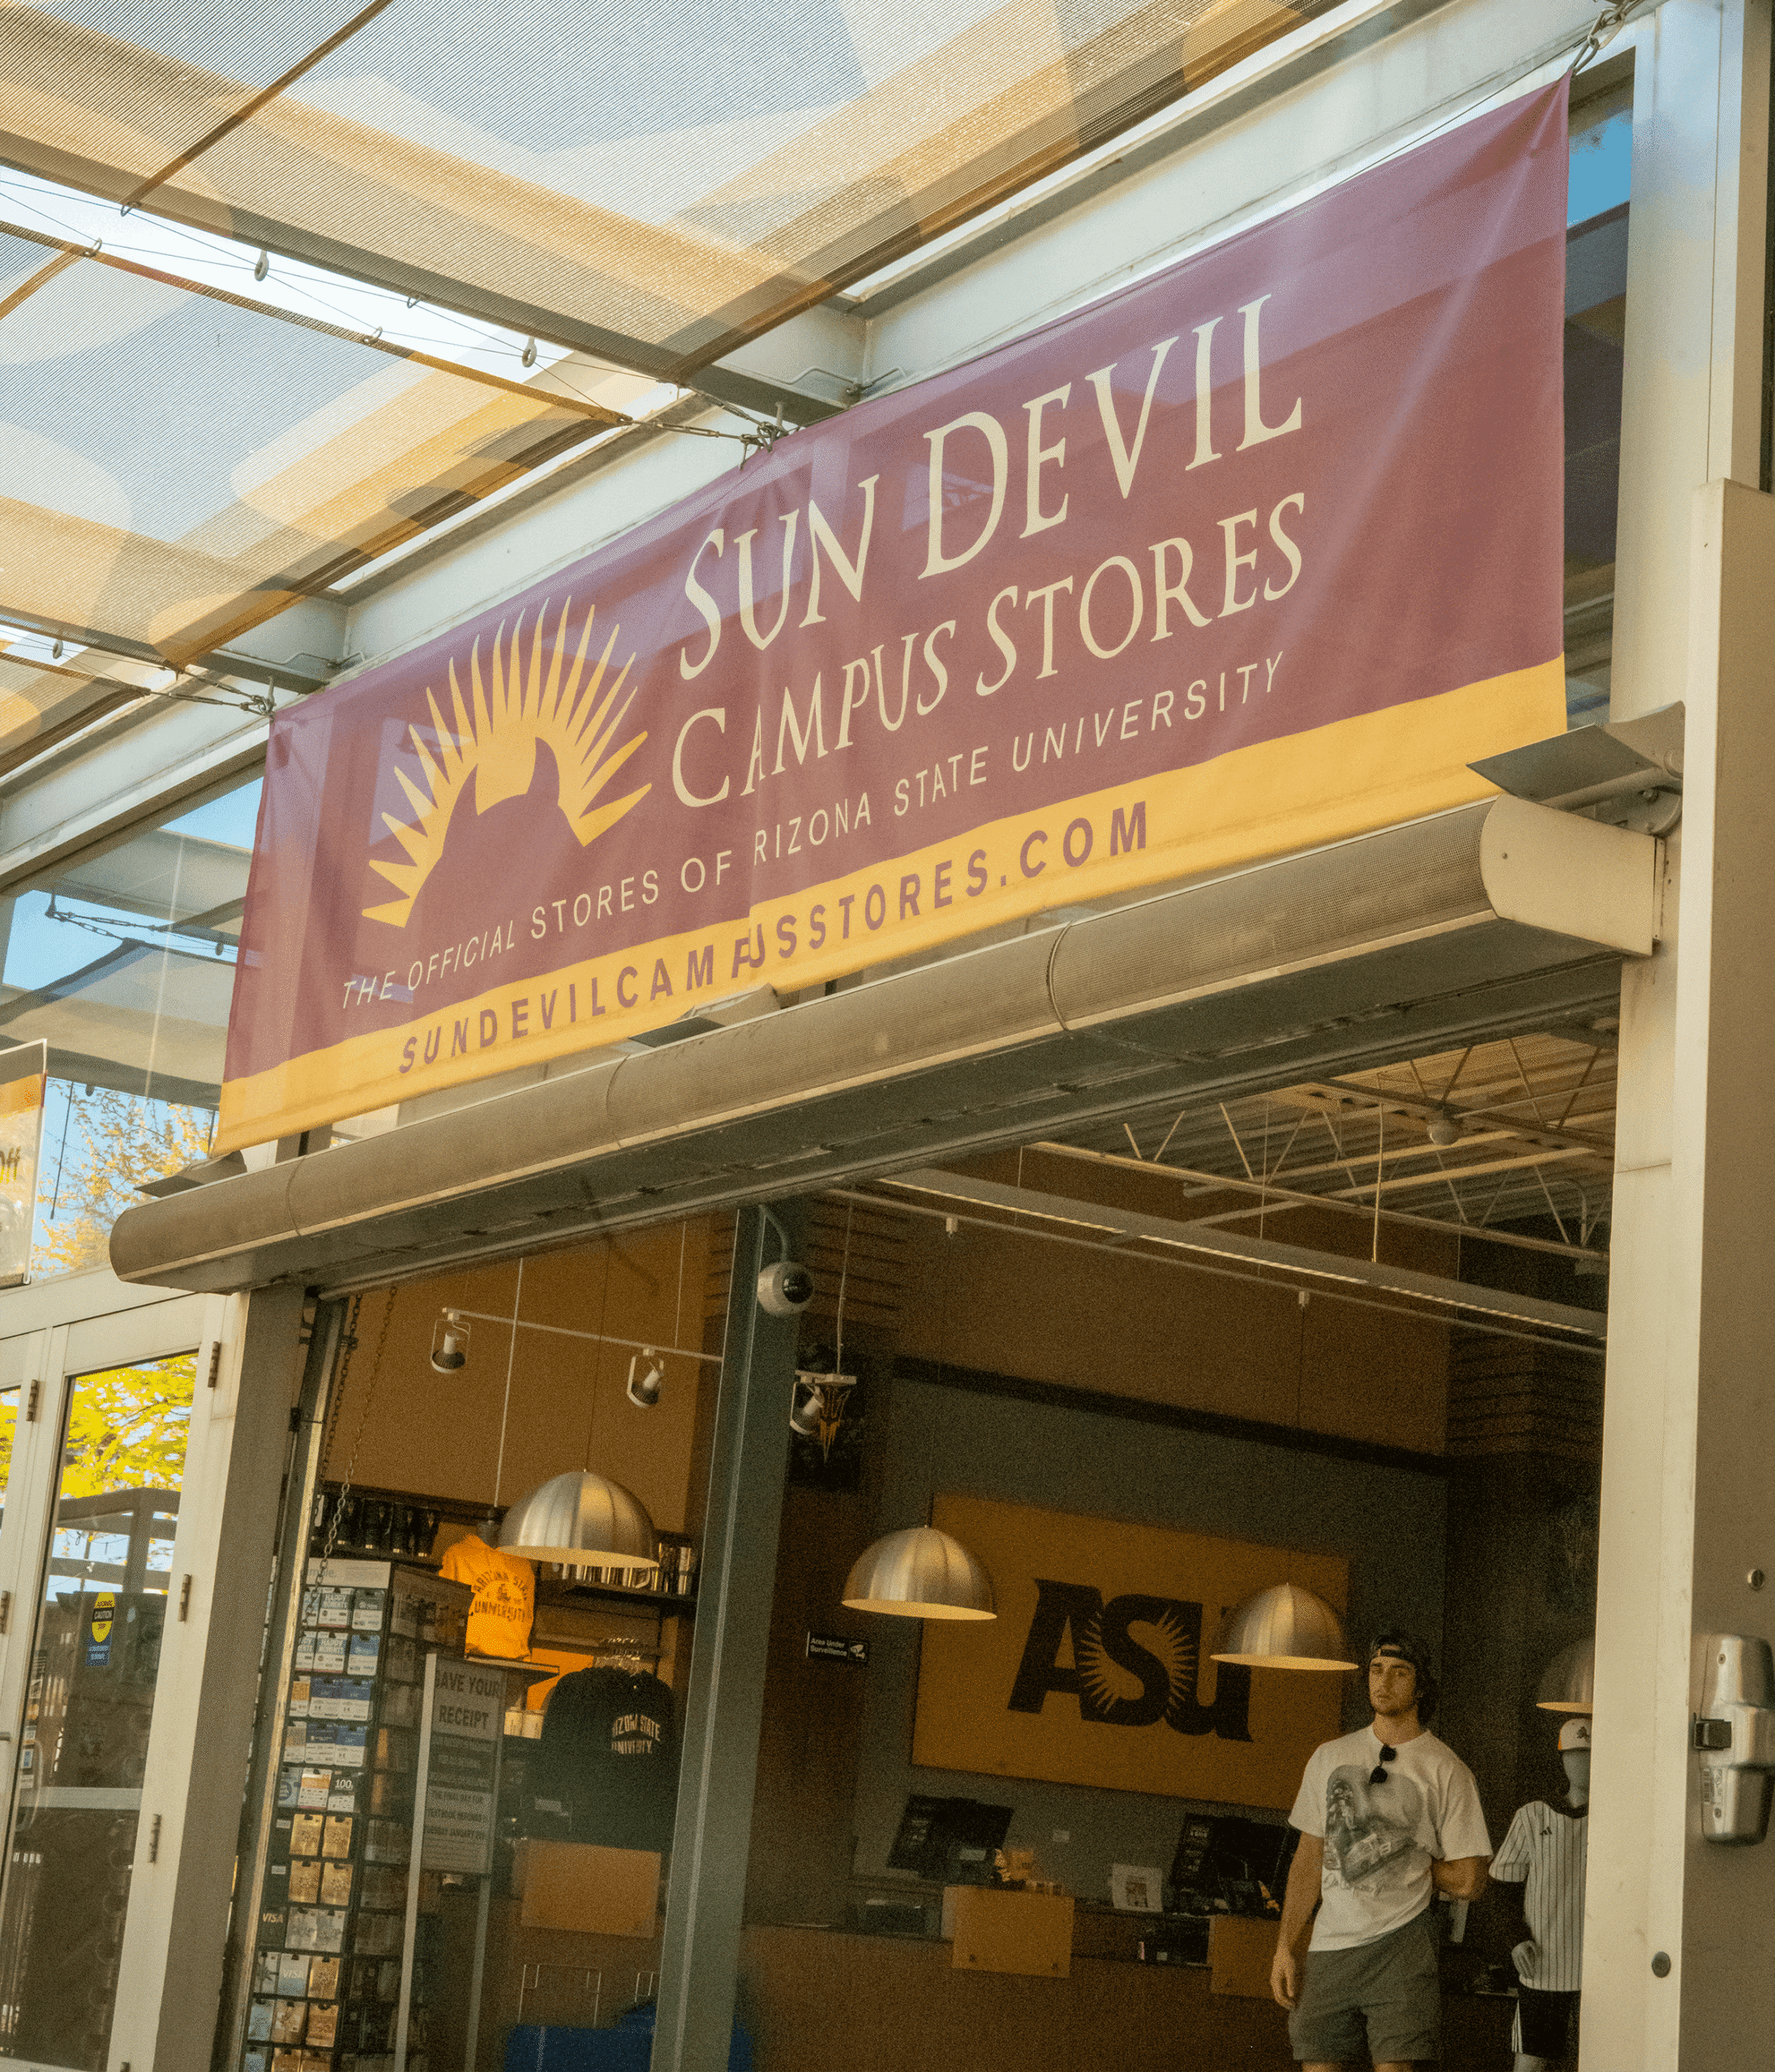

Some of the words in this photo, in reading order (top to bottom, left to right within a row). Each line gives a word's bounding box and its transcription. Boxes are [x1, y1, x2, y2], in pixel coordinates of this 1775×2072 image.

[678, 473, 880, 681] SUN
[917, 293, 1302, 580] DEVIL
[672, 620, 957, 808] CAMPUS
[975, 492, 1305, 697] STORES
[342, 970, 397, 1009] THE
[406, 919, 516, 992] OFFICIAL
[530, 869, 660, 940] STORES
[680, 850, 733, 893] OF
[754, 792, 872, 866] RIZONA
[894, 746, 989, 817] STATE
[1012, 651, 1284, 773] UNIVERSITY
[398, 800, 1147, 1075] SUNDEVILCAMPUSSTORES.COM
[439, 1705, 489, 1729] RECEIPT
[1007, 1578, 1254, 1743] ASU
[262, 1913, 283, 1923] VISA
